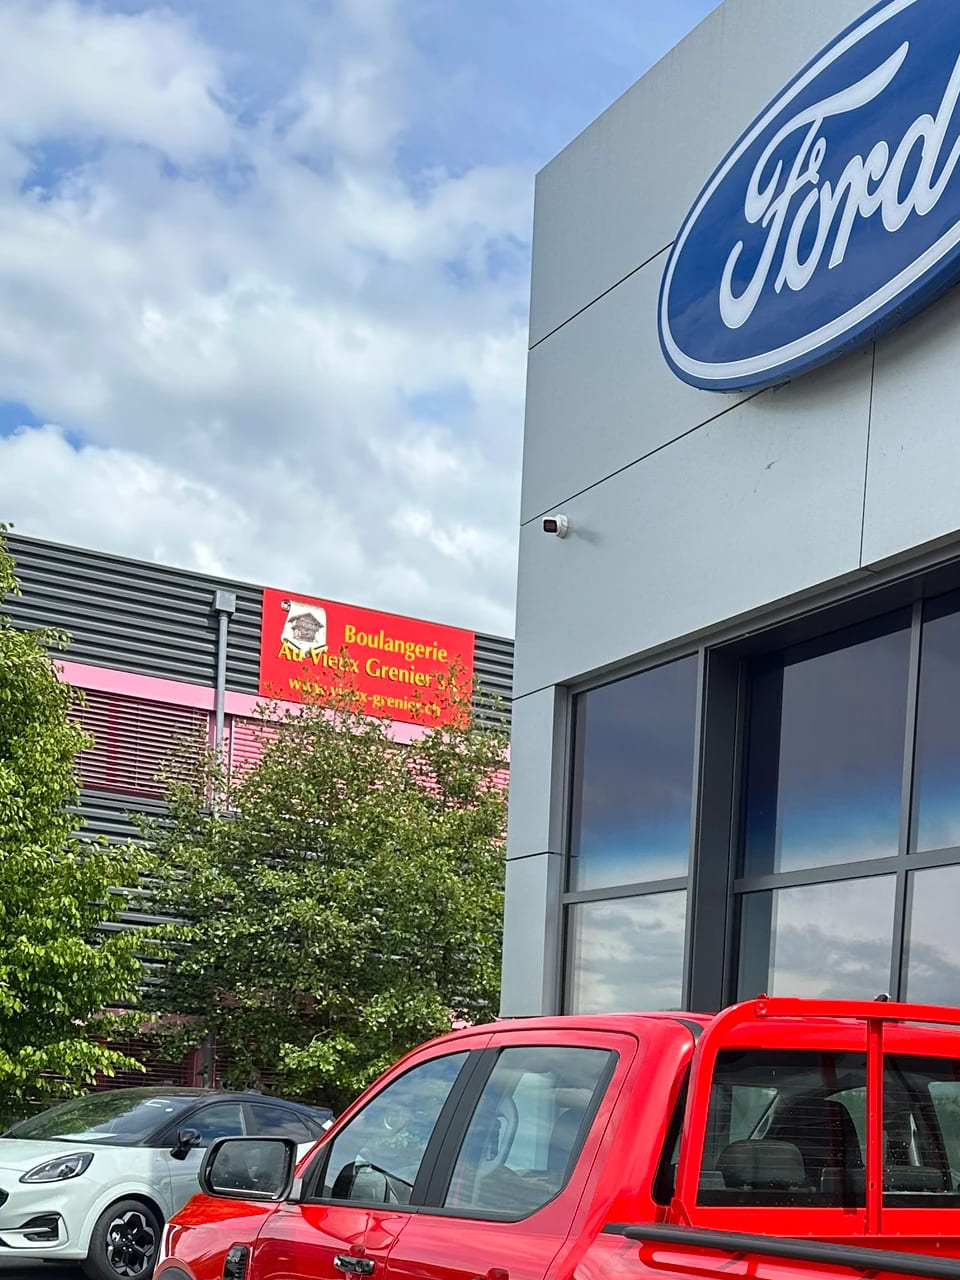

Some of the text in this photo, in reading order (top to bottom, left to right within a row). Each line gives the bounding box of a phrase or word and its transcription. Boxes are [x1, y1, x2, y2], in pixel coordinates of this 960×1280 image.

[277, 641, 304, 662] Au
[365, 658, 432, 687] Grenier
[344, 624, 448, 663] Boulangerie
